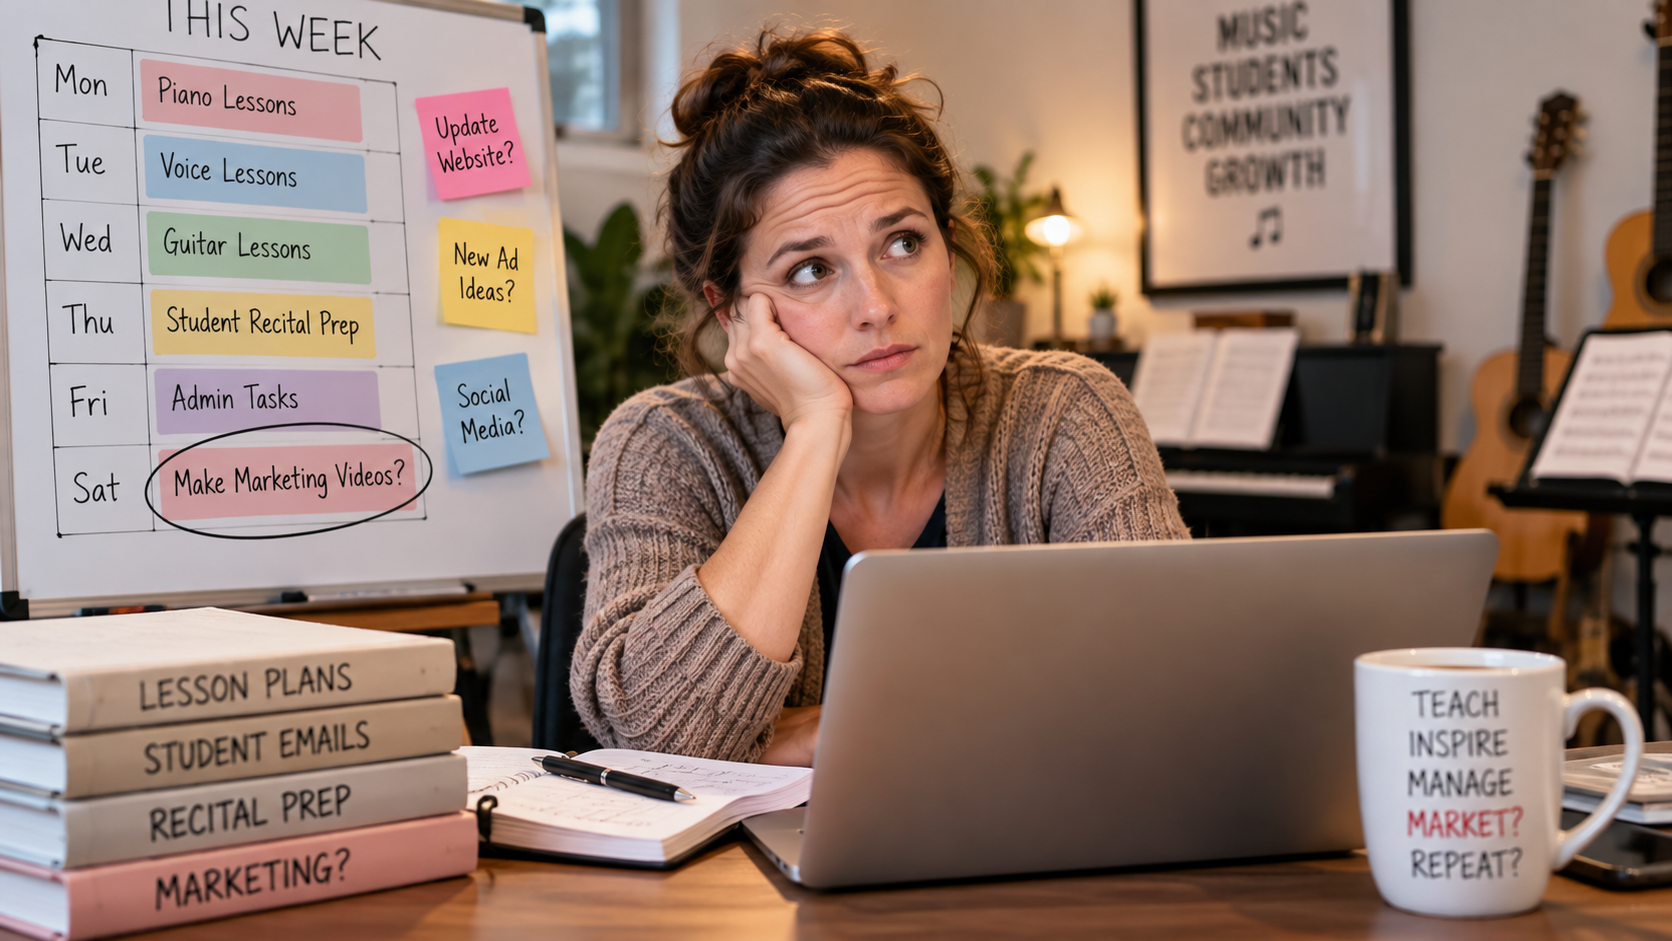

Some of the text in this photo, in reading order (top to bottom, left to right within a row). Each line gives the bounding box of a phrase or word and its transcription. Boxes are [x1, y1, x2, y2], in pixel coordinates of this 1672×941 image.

[273, 10, 382, 61] WEEK
[1216, 1, 1308, 52] MUSIC
[55, 63, 108, 97] Mon
[1191, 45, 1339, 103] STUDENTS
[158, 75, 297, 116] Piano Lessons
[435, 112, 499, 146] Update
[1182, 94, 1350, 152] COMMUNITY
[55, 143, 106, 175] Tue
[160, 151, 298, 188] Voice Lessons
[436, 140, 514, 173] Website?
[1204, 147, 1327, 197] GROWTH
[59, 222, 112, 253] Wed
[163, 226, 311, 260] Guitar Lessons
[454, 241, 519, 272] New Ad
[459, 276, 516, 302] Ideas?
[61, 303, 114, 335] Thu
[166, 305, 360, 345] Student Recital Prep
[69, 384, 107, 418] Fri
[171, 383, 299, 412] Admin Tasks
[457, 377, 511, 409] Social
[460, 409, 525, 444] Media?
[73, 471, 121, 504] Sat
[174, 458, 405, 500] Make Marketing Videos?
[139, 662, 353, 711] LESSON PLANS
[1412, 688, 1500, 719] TEACH
[143, 720, 371, 775] STUDENT EMAILS
[1409, 728, 1509, 758] INSPIRE
[1408, 767, 1514, 798] MANAGE
[149, 784, 352, 842] RECITAL PREP
[1408, 804, 1525, 839] MARKET?
[154, 847, 352, 911] MARKETING?
[1411, 845, 1525, 880] REPEAT?
